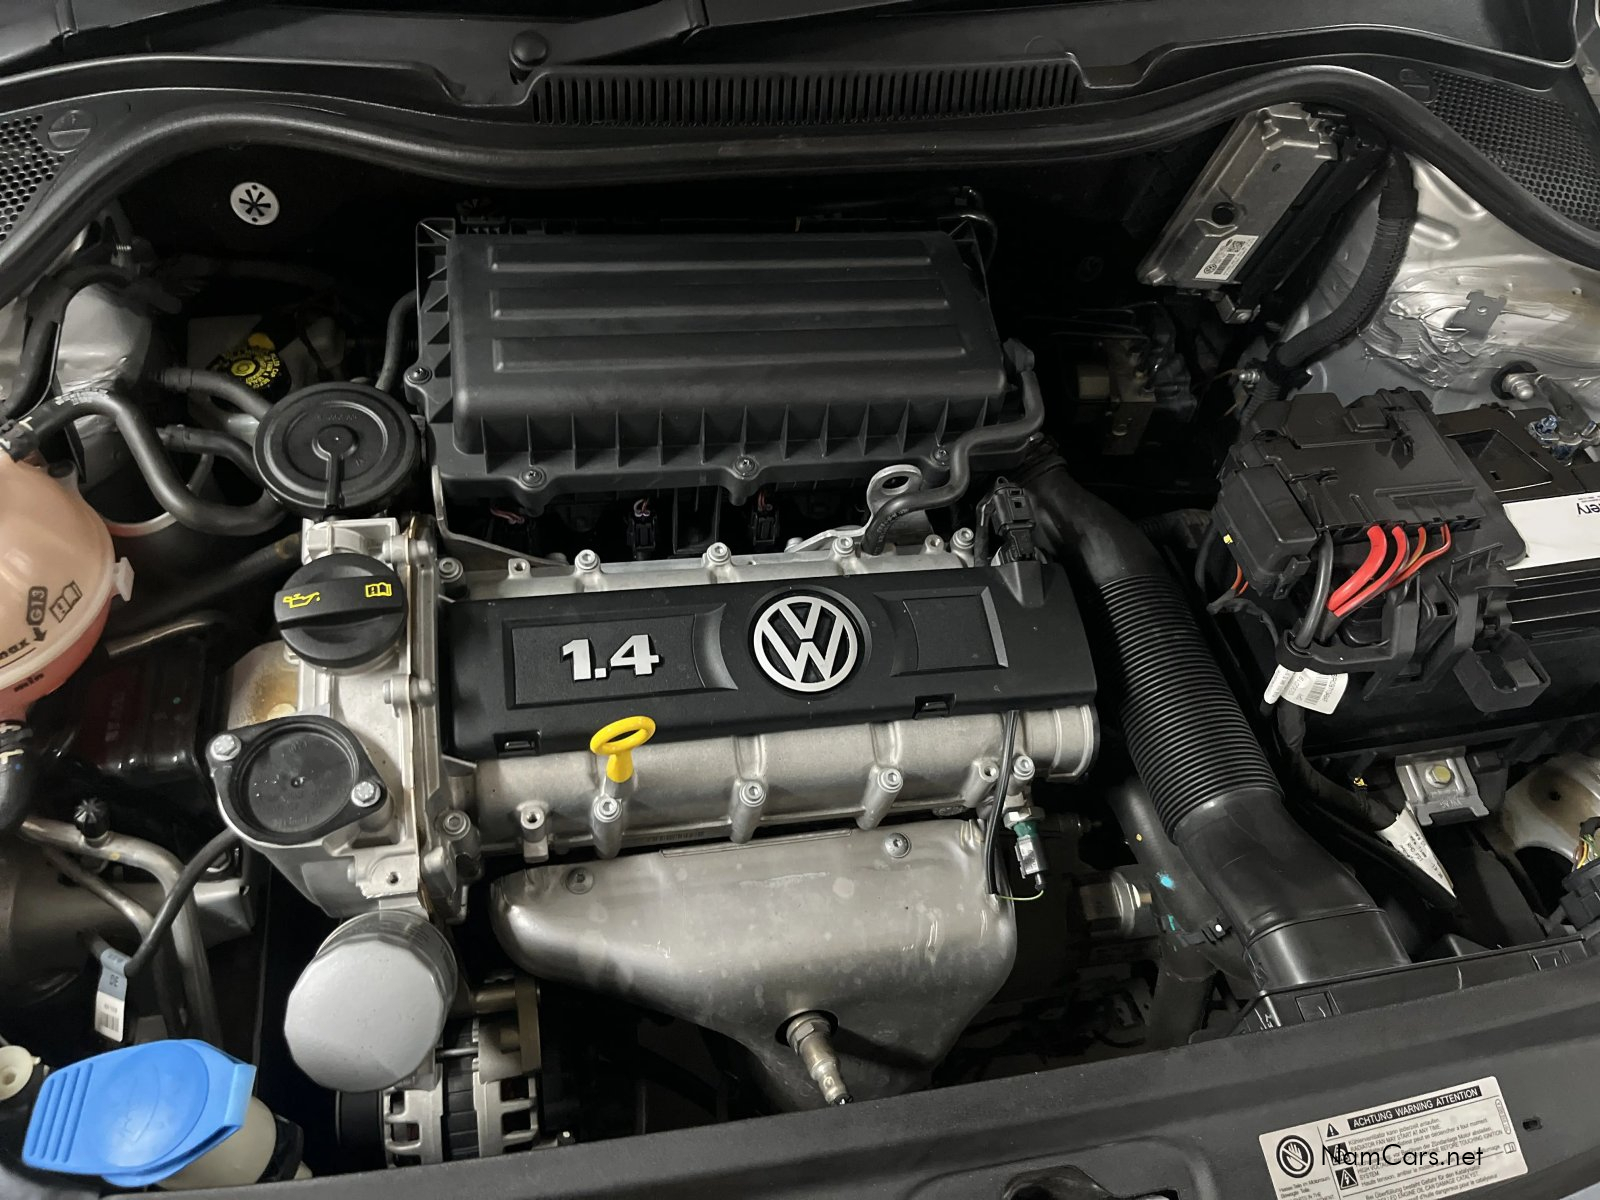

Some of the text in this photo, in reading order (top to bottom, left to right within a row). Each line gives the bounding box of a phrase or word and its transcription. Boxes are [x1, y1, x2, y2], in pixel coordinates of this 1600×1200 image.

[562, 634, 660, 681] 1.4
[14, 673, 44, 692] min
[1353, 1088, 1479, 1128] ACHTUNG WARNING ATTENTION
